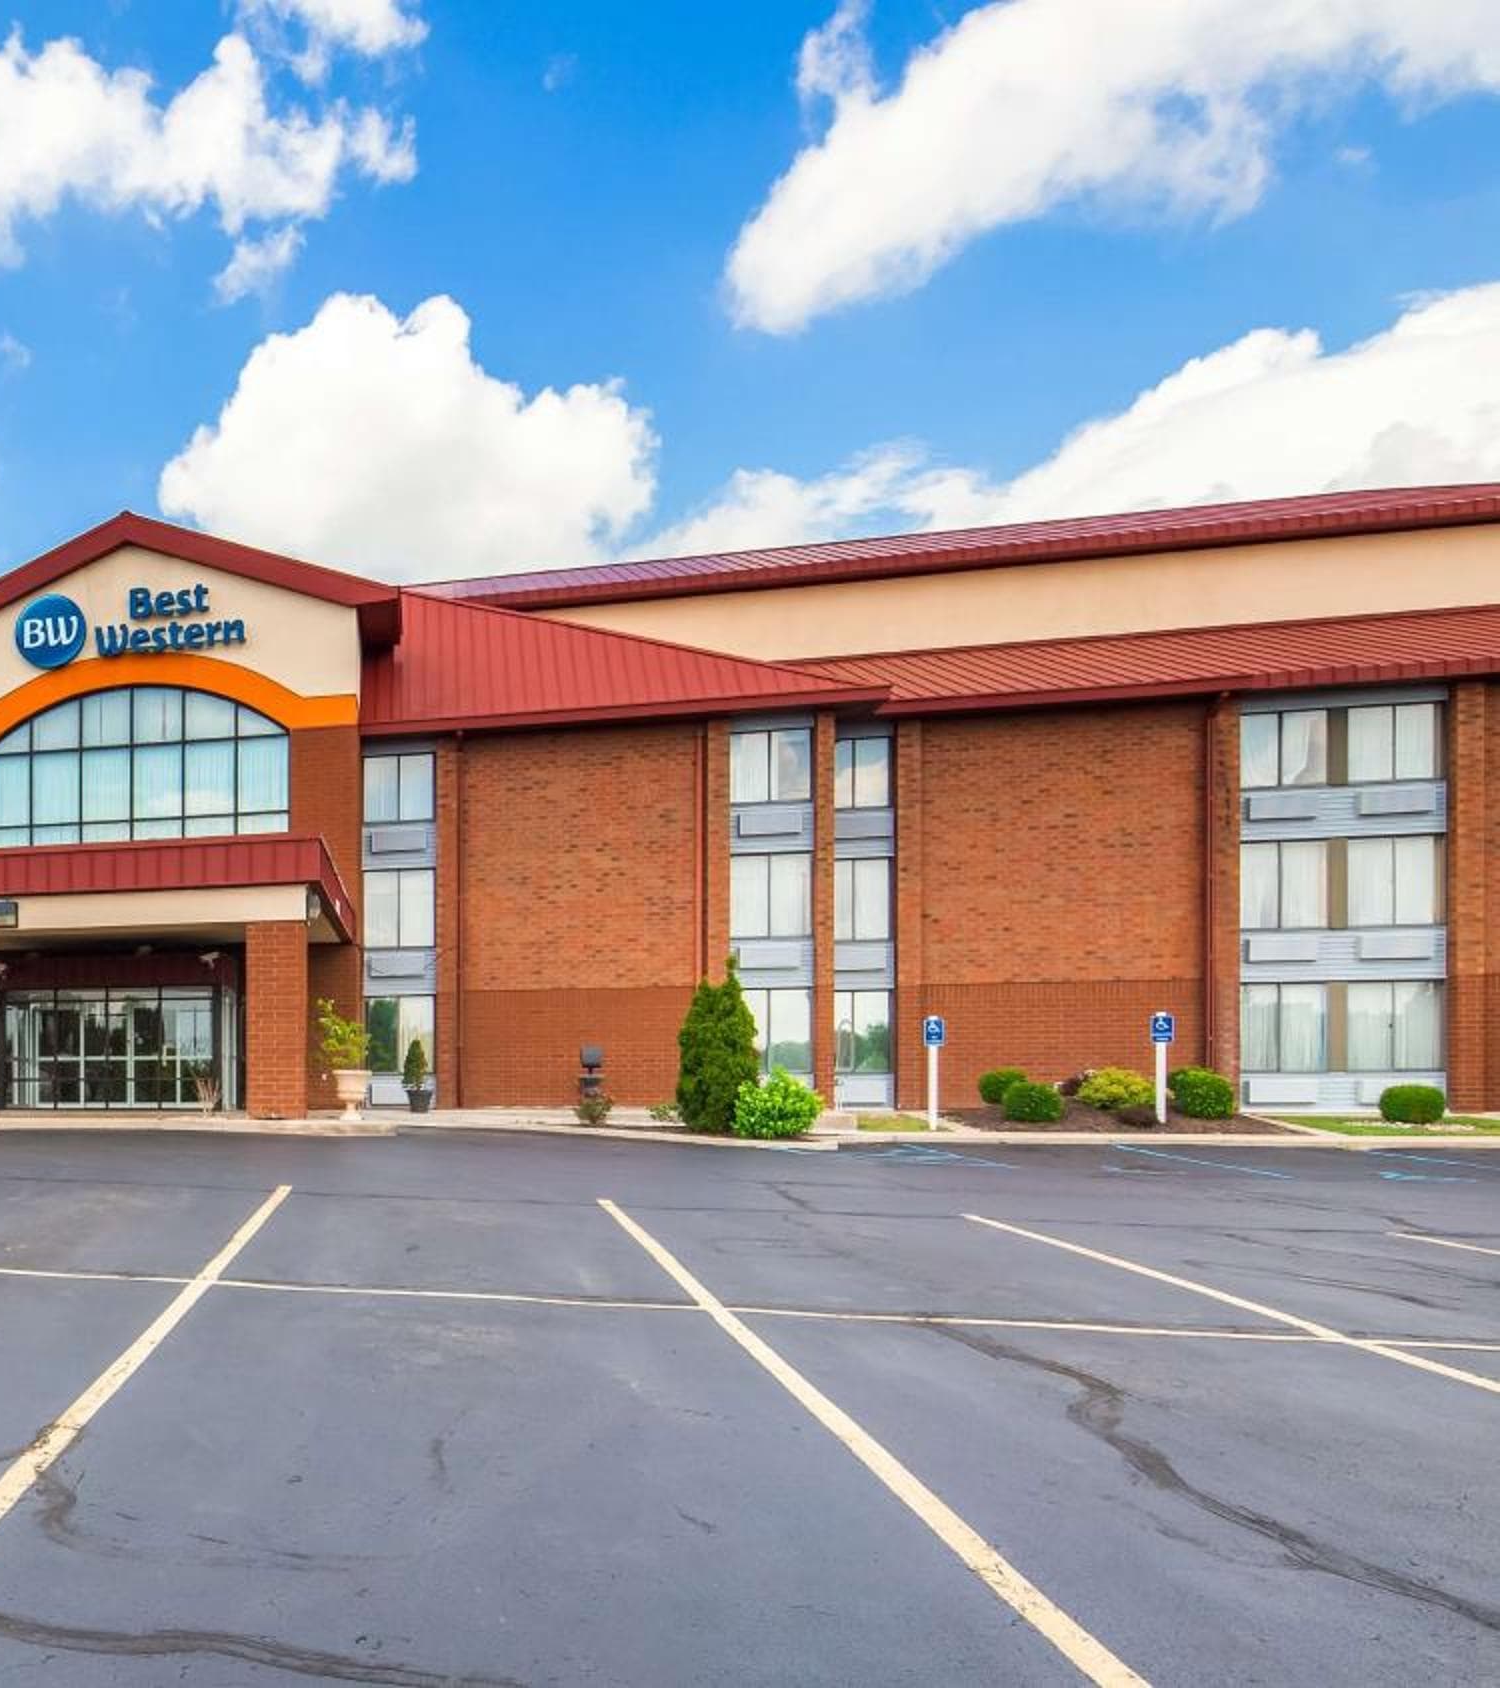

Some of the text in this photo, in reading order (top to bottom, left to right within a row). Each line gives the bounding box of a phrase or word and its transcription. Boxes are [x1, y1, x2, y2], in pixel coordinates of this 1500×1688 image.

[129, 583, 210, 620] Best
[23, 615, 79, 649] BW
[94, 618, 246, 658] Western
